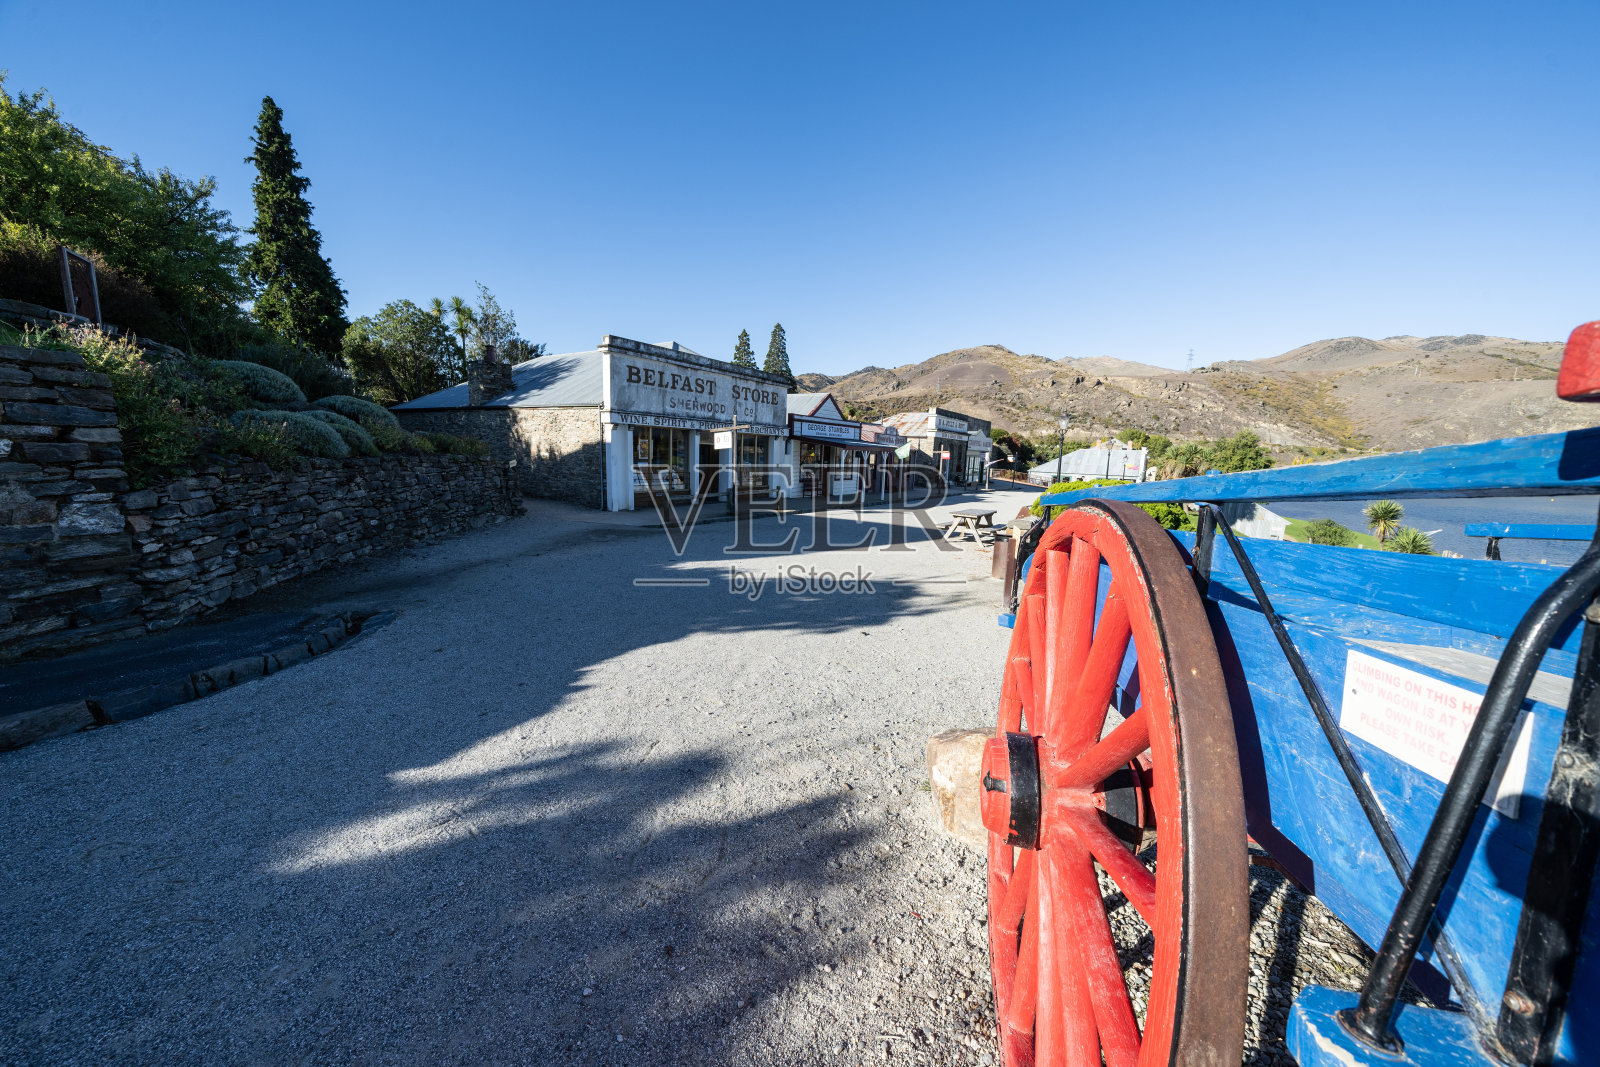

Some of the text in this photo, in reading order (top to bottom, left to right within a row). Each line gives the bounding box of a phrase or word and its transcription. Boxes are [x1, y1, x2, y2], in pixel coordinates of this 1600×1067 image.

[626, 365, 779, 405] BELFAST STORE
[669, 397, 726, 414] SHERWOOD
[653, 416, 688, 427] SPIRIT
[807, 423, 827, 432] GEORGE
[1352, 660, 1401, 688] CLIMBING
[1404, 680, 1423, 696] ON
[1426, 687, 1457, 709] THIS
[1355, 677, 1375, 694] AND
[1376, 686, 1419, 714] WAGON
[1422, 702, 1435, 719] IS
[1439, 713, 1457, 729] AT
[1384, 707, 1412, 728] OWN
[1360, 712, 1400, 741] PLEASE
[1403, 733, 1435, 758] TAKE
